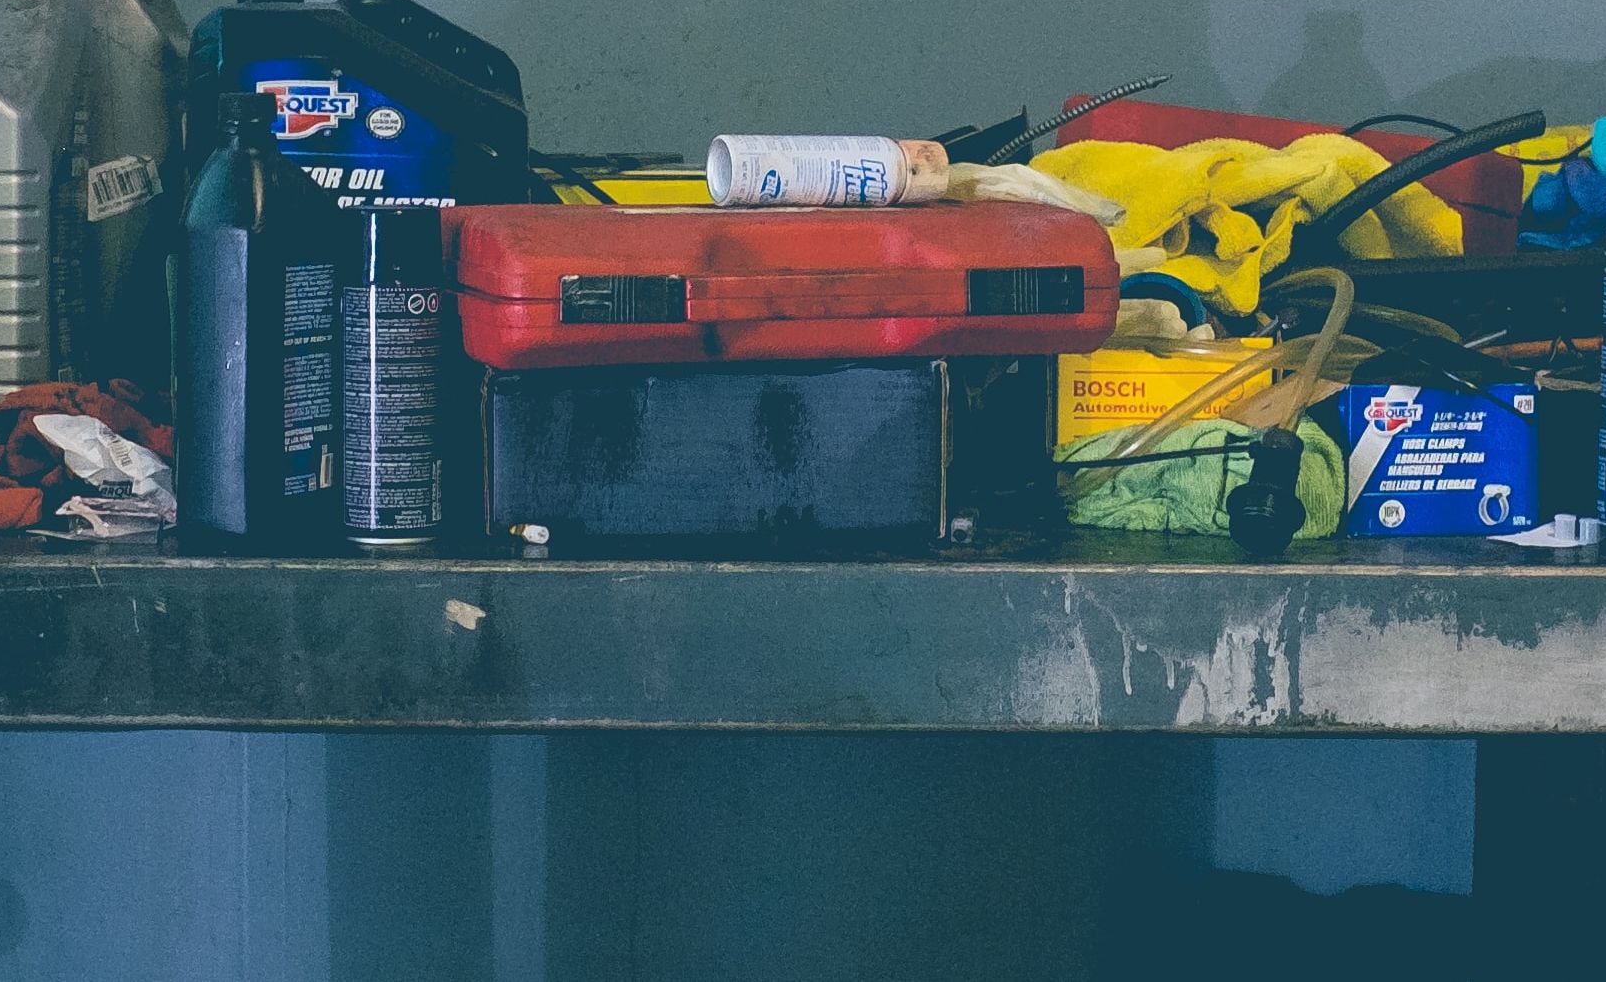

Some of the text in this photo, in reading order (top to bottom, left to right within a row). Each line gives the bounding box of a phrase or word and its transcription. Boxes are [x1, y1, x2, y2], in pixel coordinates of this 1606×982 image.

[348, 168, 385, 190] OIL
[1072, 380, 1146, 398] BOSCH
[1072, 401, 1167, 414] Automotive
[1427, 437, 1467, 450] CLAMPS
[1459, 451, 1485, 464] PARA
[1422, 479, 1435, 491] DE
